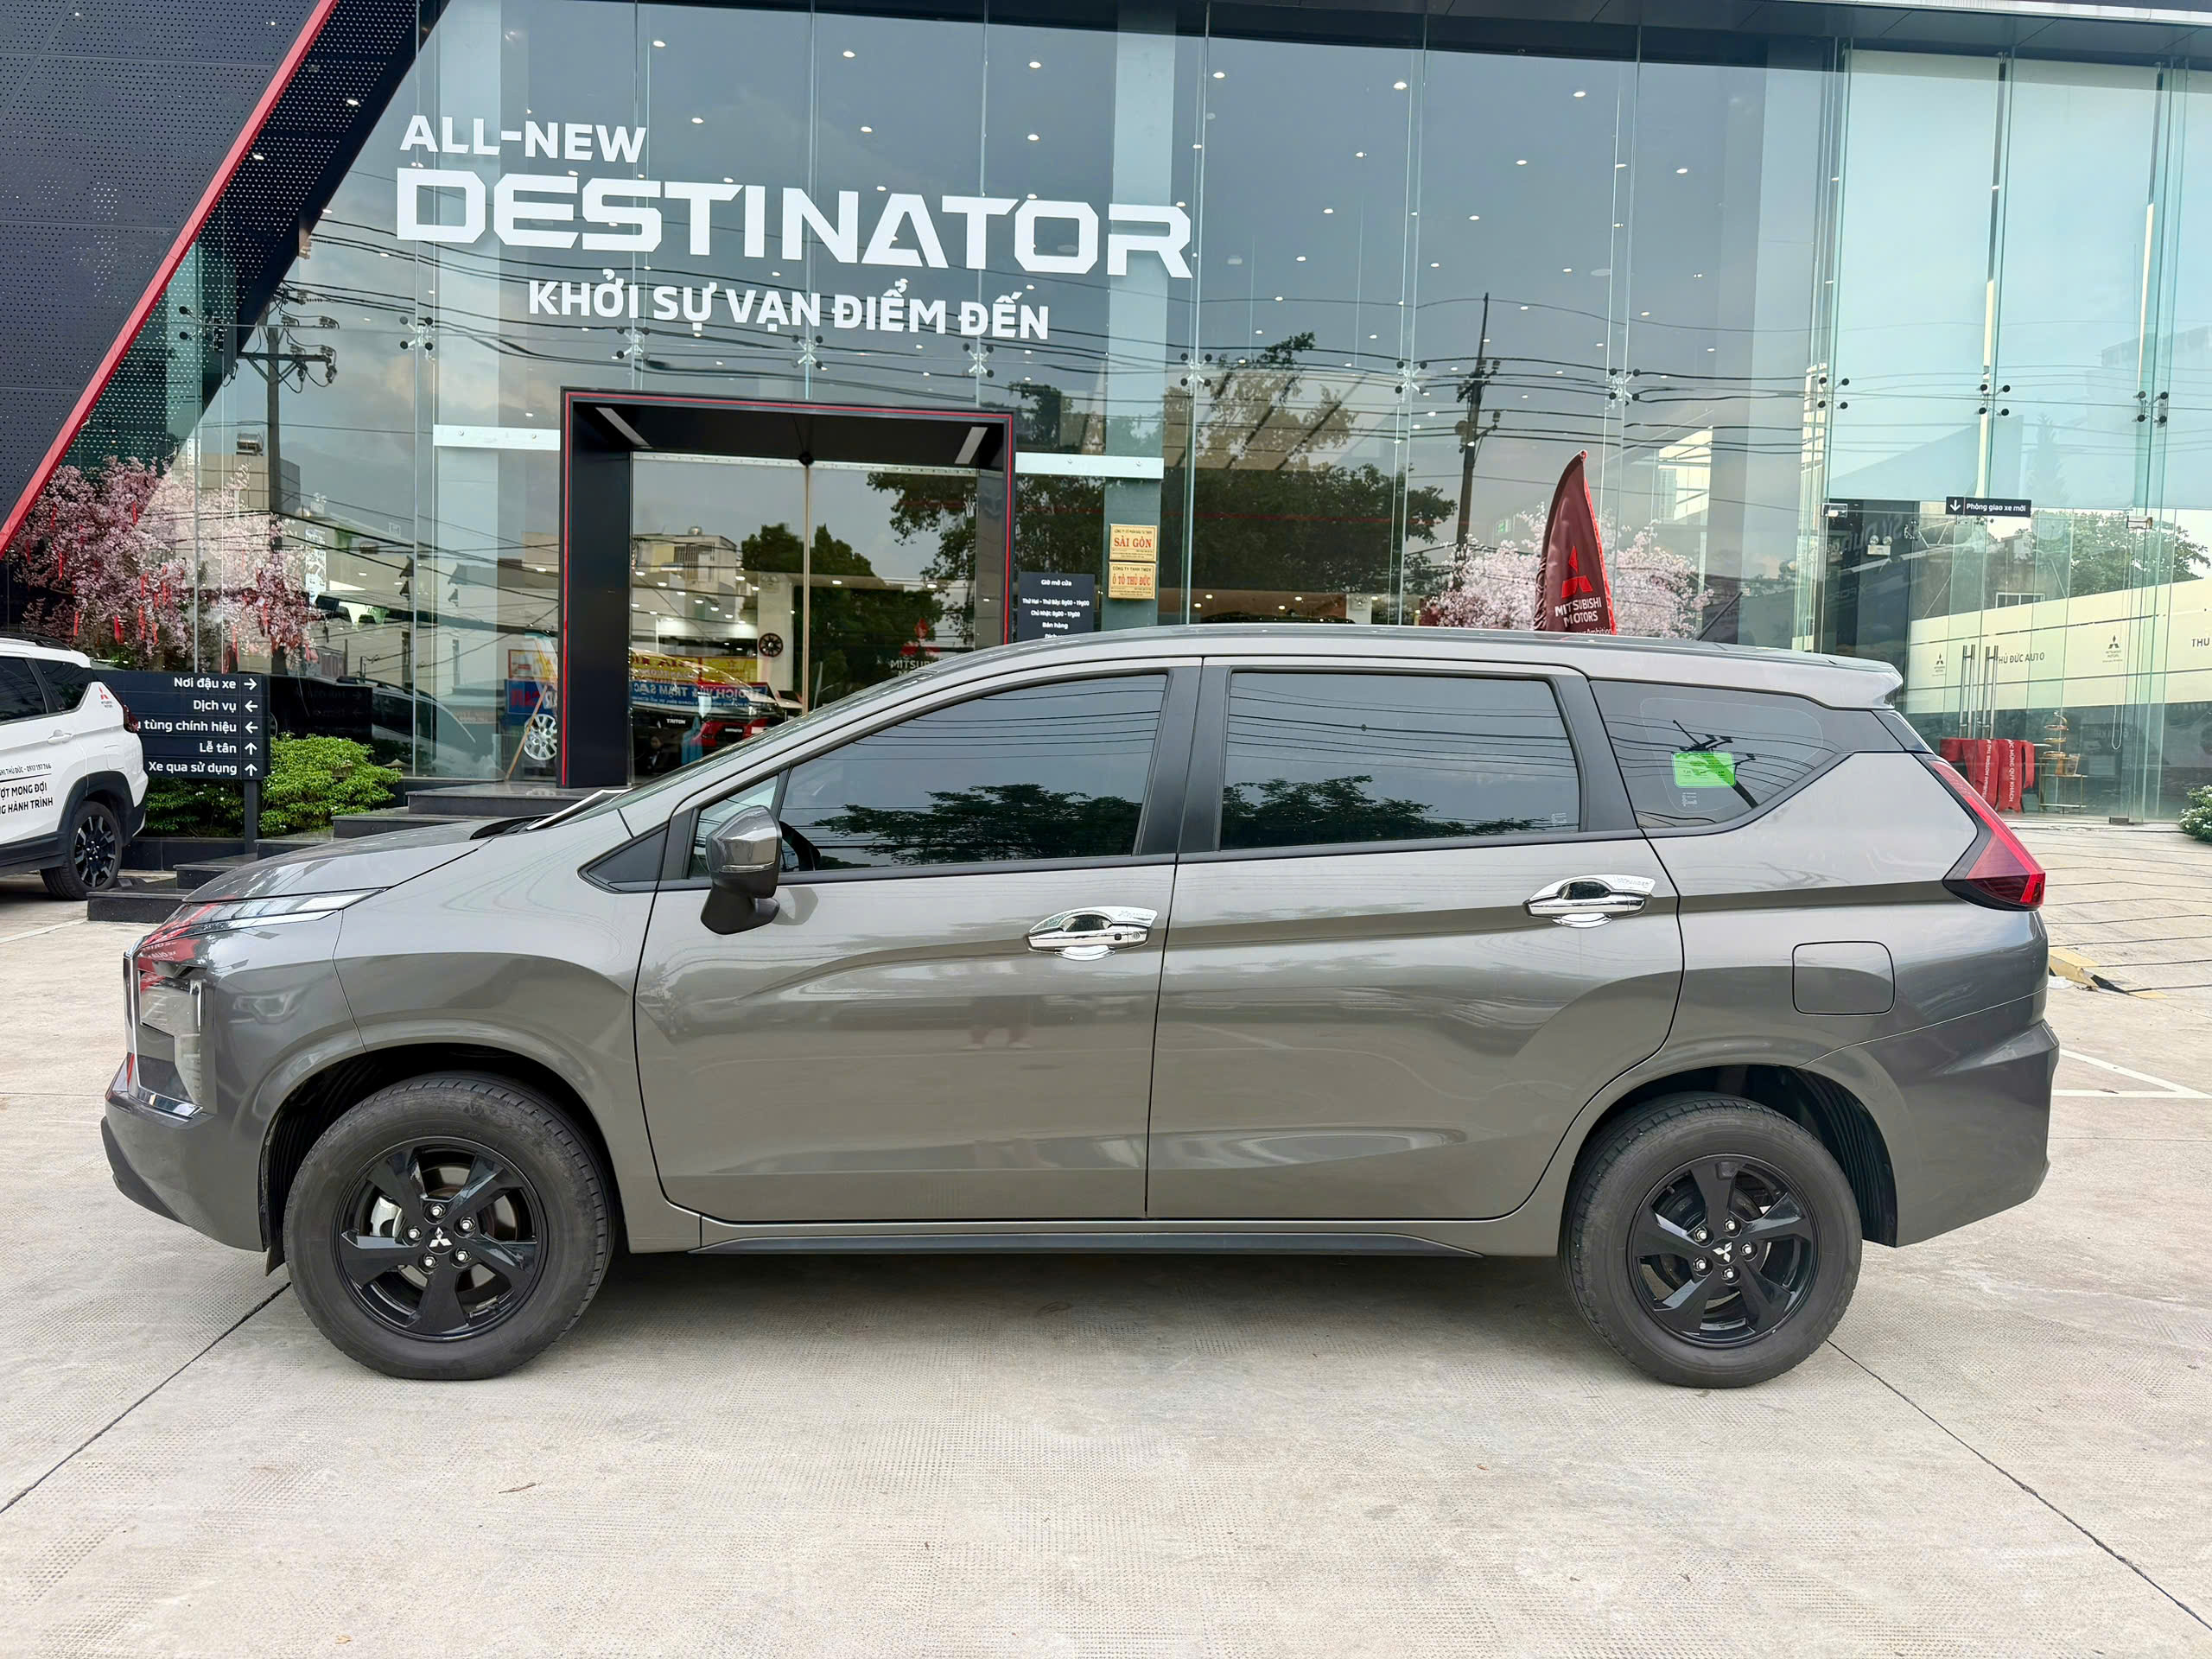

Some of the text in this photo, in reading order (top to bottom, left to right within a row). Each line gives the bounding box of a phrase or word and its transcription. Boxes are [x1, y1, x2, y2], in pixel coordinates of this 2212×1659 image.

[399, 114, 647, 163] ALL-NEW
[397, 167, 1192, 278] DESTINATOR
[529, 268, 1049, 340] KHỞI SỰ VẠN ĐIỂM ĐẾN
[1967, 502, 1987, 512] Phòng
[1114, 535, 1152, 548] SÀI GÒN
[1127, 573, 1138, 586] THỦ
[1139, 575, 1151, 586] ĐỨC
[1554, 596, 1602, 617] MITSUBISHI
[1563, 610, 1599, 627] MOTORS
[2009, 652, 2024, 663] ĐỨC
[2024, 652, 2045, 662] AUTO
[174, 677, 237, 690] Nơi đậu xe
[193, 699, 237, 713] Dịch vụ
[143, 719, 173, 732] tùng
[175, 720, 208, 732] chính
[211, 721, 237, 734] hiệu
[200, 741, 237, 753] Lễ tân
[149, 761, 237, 775] Xe qua sử dụng
[0, 781, 48, 801] ỢT MONG ĐỢI
[8, 800, 29, 813] HÀNH
[30, 797, 54, 810] TRÌNH
